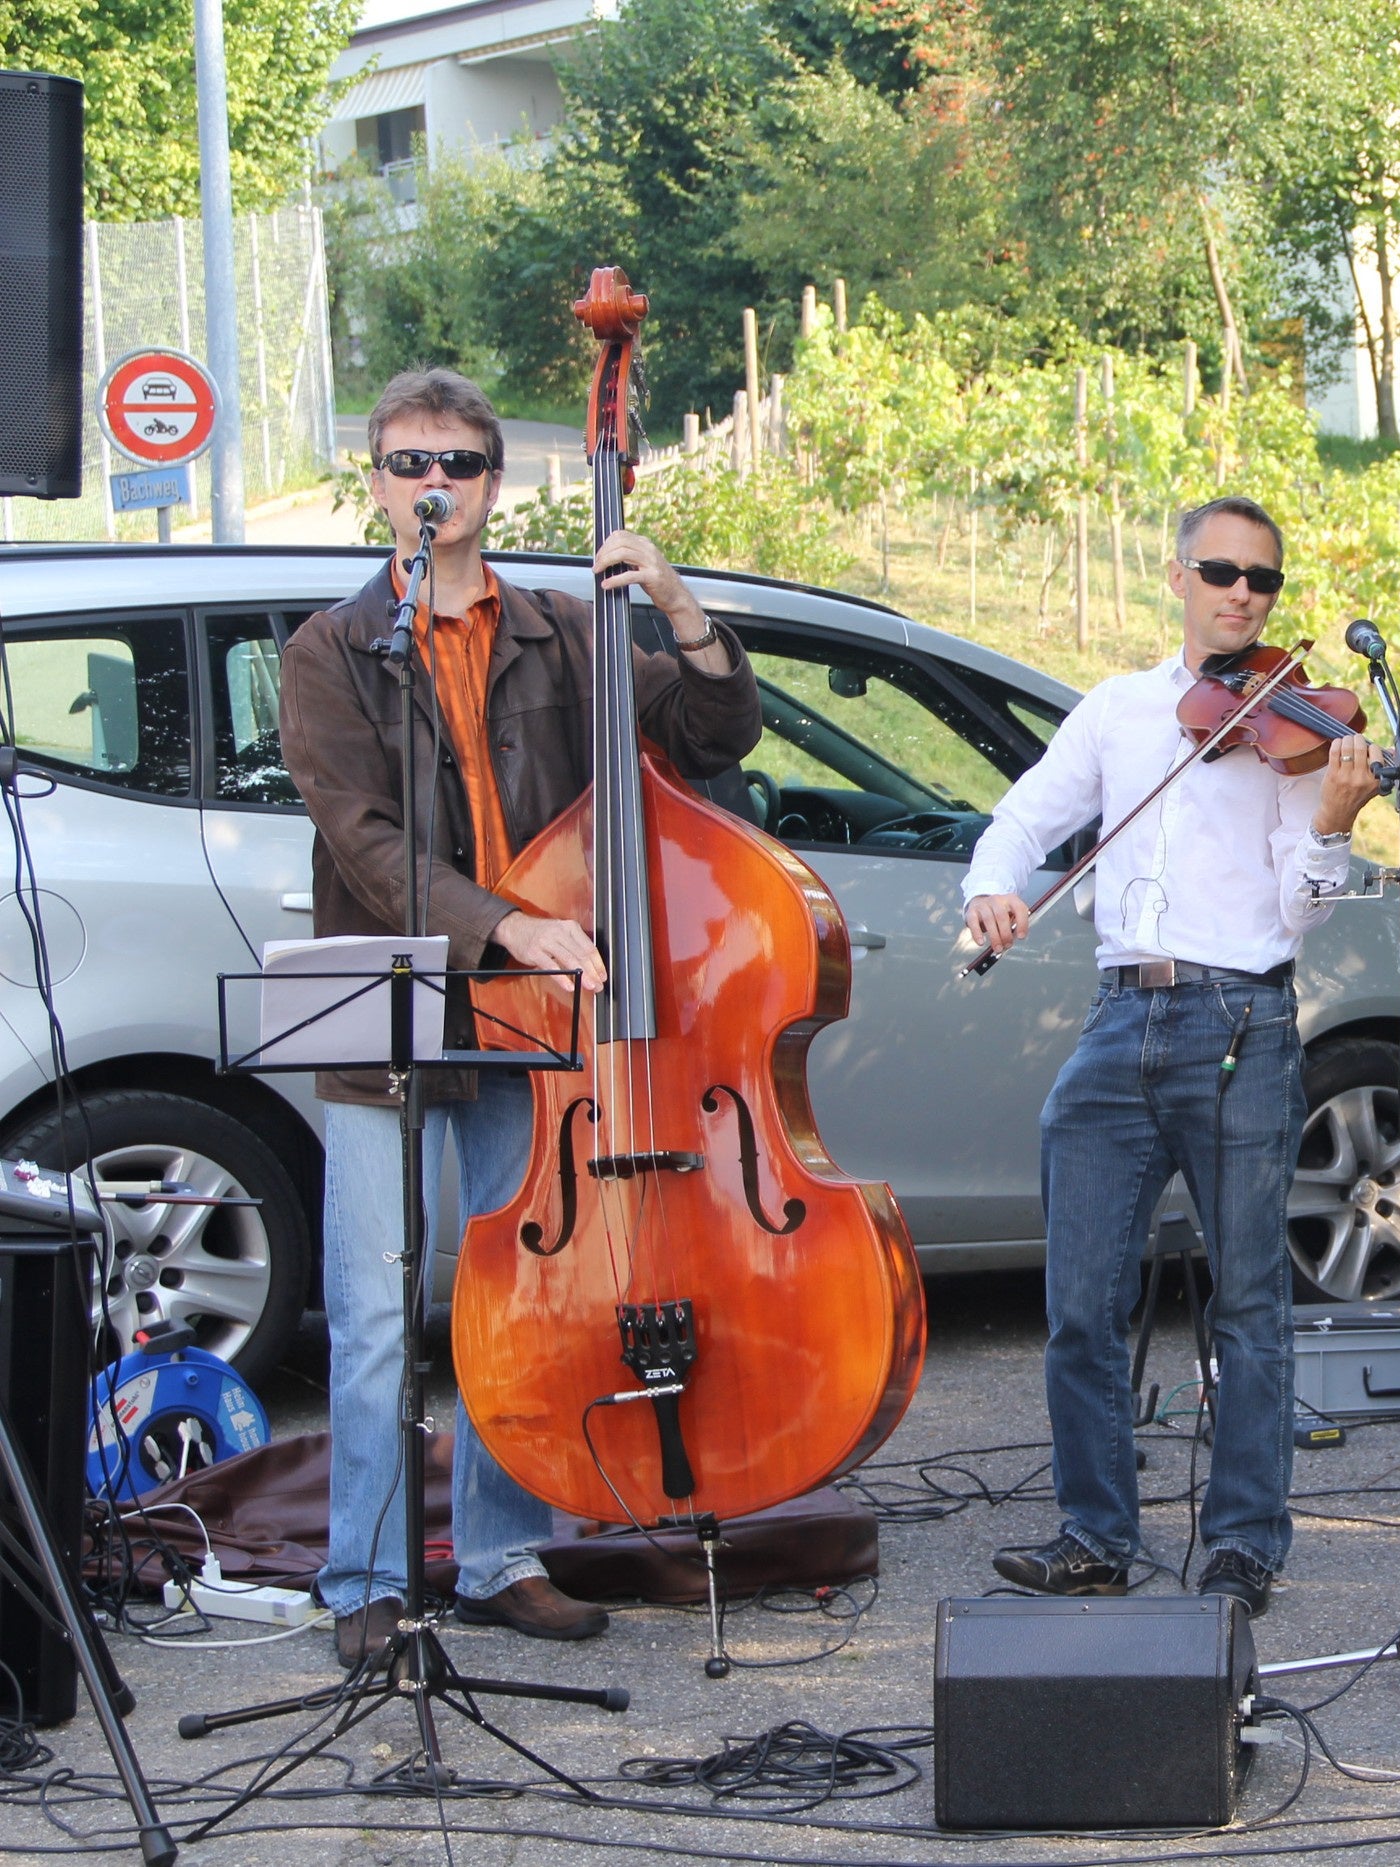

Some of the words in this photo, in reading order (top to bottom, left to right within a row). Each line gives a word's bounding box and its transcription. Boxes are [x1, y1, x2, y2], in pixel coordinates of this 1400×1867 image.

[120, 478, 179, 503] Bachweg
[645, 1367, 675, 1379] ZETA
[223, 1391, 236, 1413] Haus
[239, 1431, 252, 1452] hous
